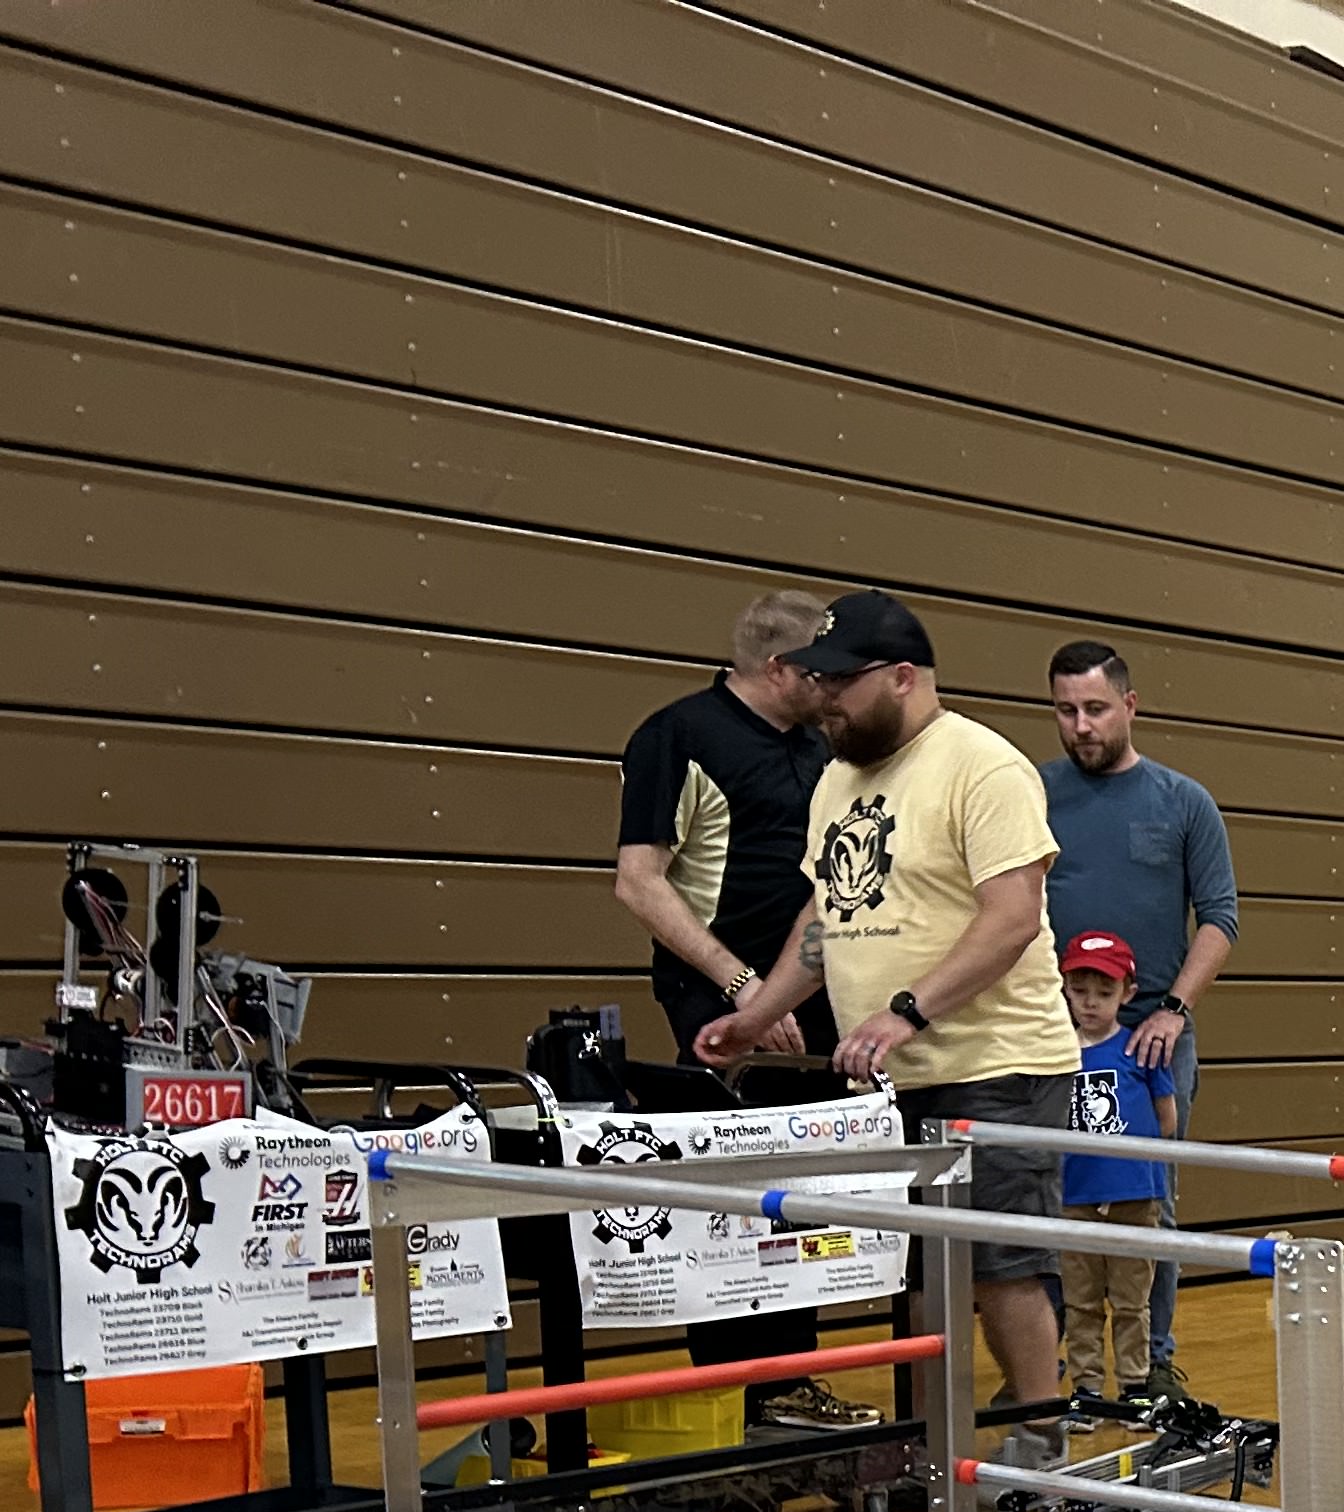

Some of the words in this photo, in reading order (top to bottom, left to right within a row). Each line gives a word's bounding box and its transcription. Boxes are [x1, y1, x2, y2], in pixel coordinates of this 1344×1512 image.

[144, 1083, 242, 1122] 26617
[714, 1125, 771, 1140] Raytheon
[788, 1113, 892, 1142] Google.org
[255, 1135, 331, 1153] Raytheon
[352, 1127, 477, 1154] Google.org
[596, 1129, 631, 1154] HOLT
[634, 1129, 662, 1151] FTC
[717, 1138, 789, 1154] Technologies
[257, 1151, 350, 1169] Technologies
[252, 1203, 308, 1221] FIRST
[408, 1226, 460, 1252] Grady
[87, 1292, 111, 1304] Holt
[113, 1290, 146, 1303] Junior
[150, 1287, 179, 1301] High
[181, 1284, 213, 1297] School
